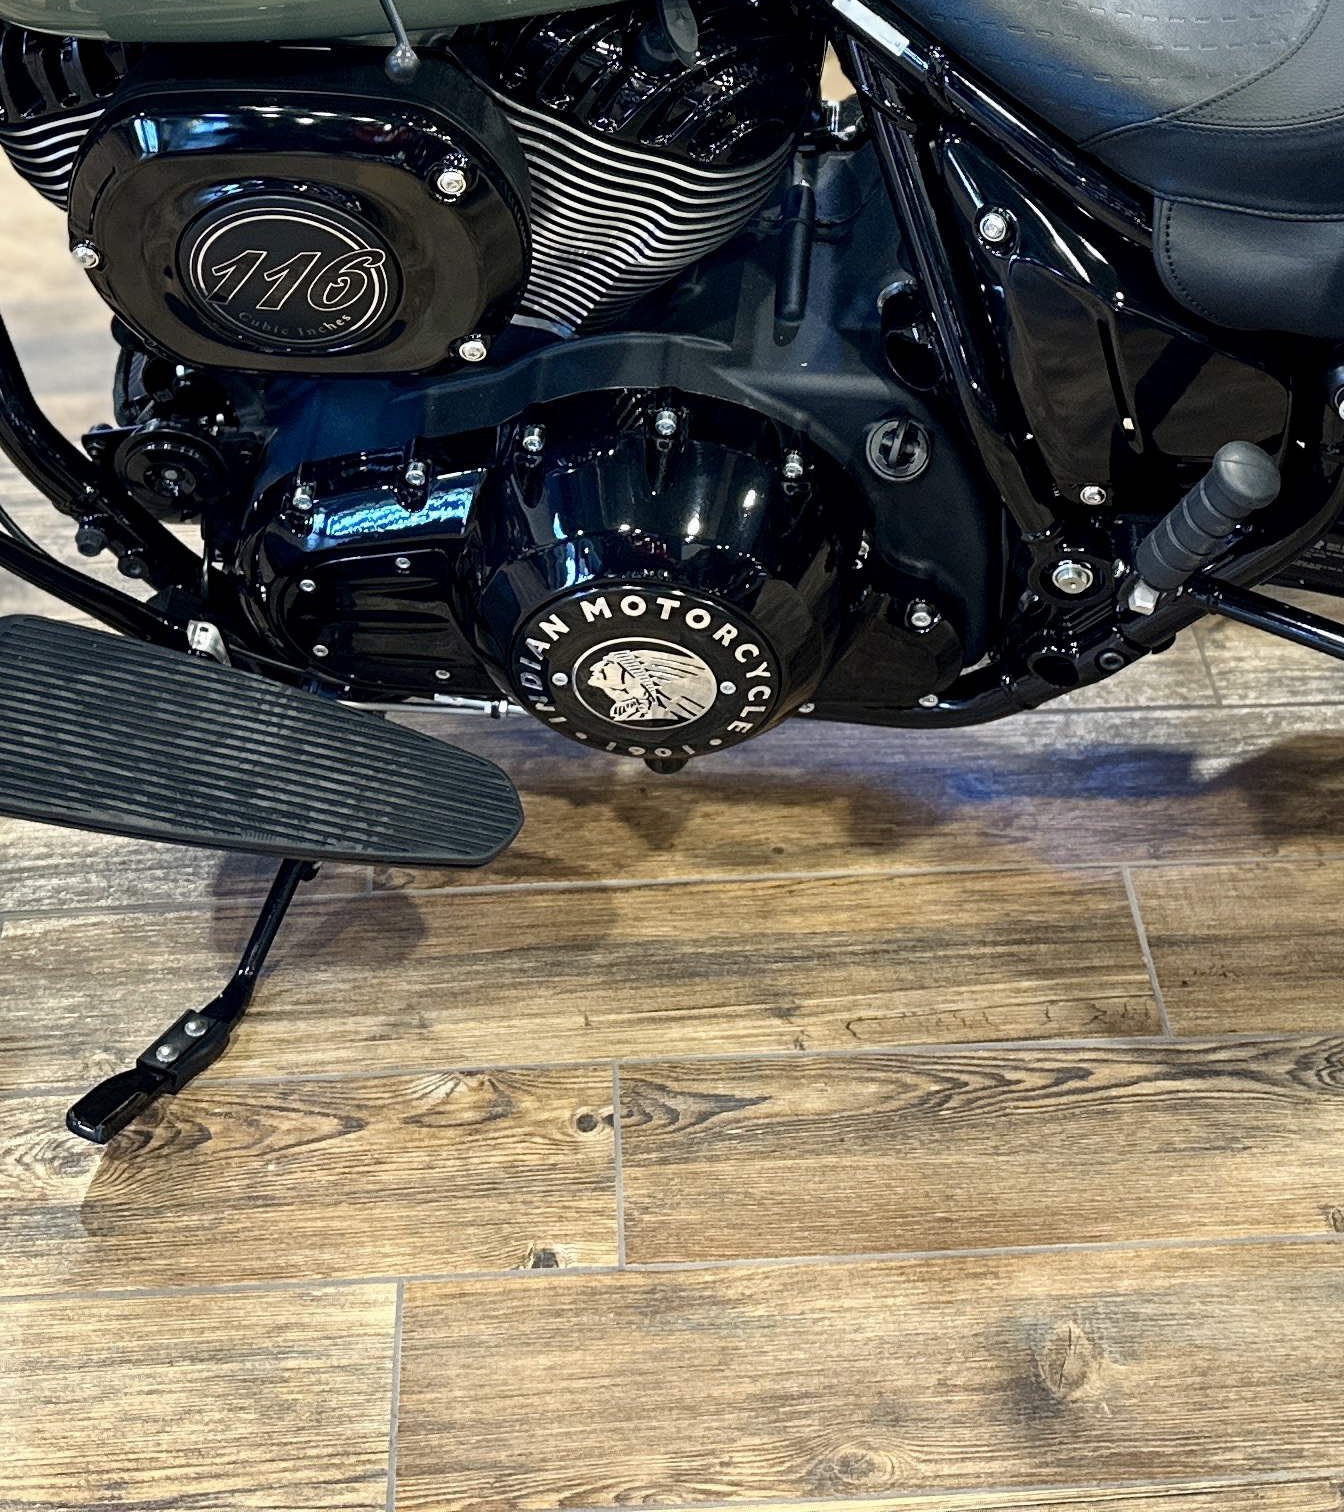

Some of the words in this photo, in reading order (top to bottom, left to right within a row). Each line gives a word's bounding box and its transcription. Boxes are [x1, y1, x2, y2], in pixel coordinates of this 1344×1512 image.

[206, 248, 386, 311] 116
[238, 311, 289, 336] Cubic
[298, 314, 352, 336] Inches
[519, 613, 570, 723] INDIAN
[580, 594, 772, 734] MOTORCYCLE
[605, 741, 696, 758] 1901
